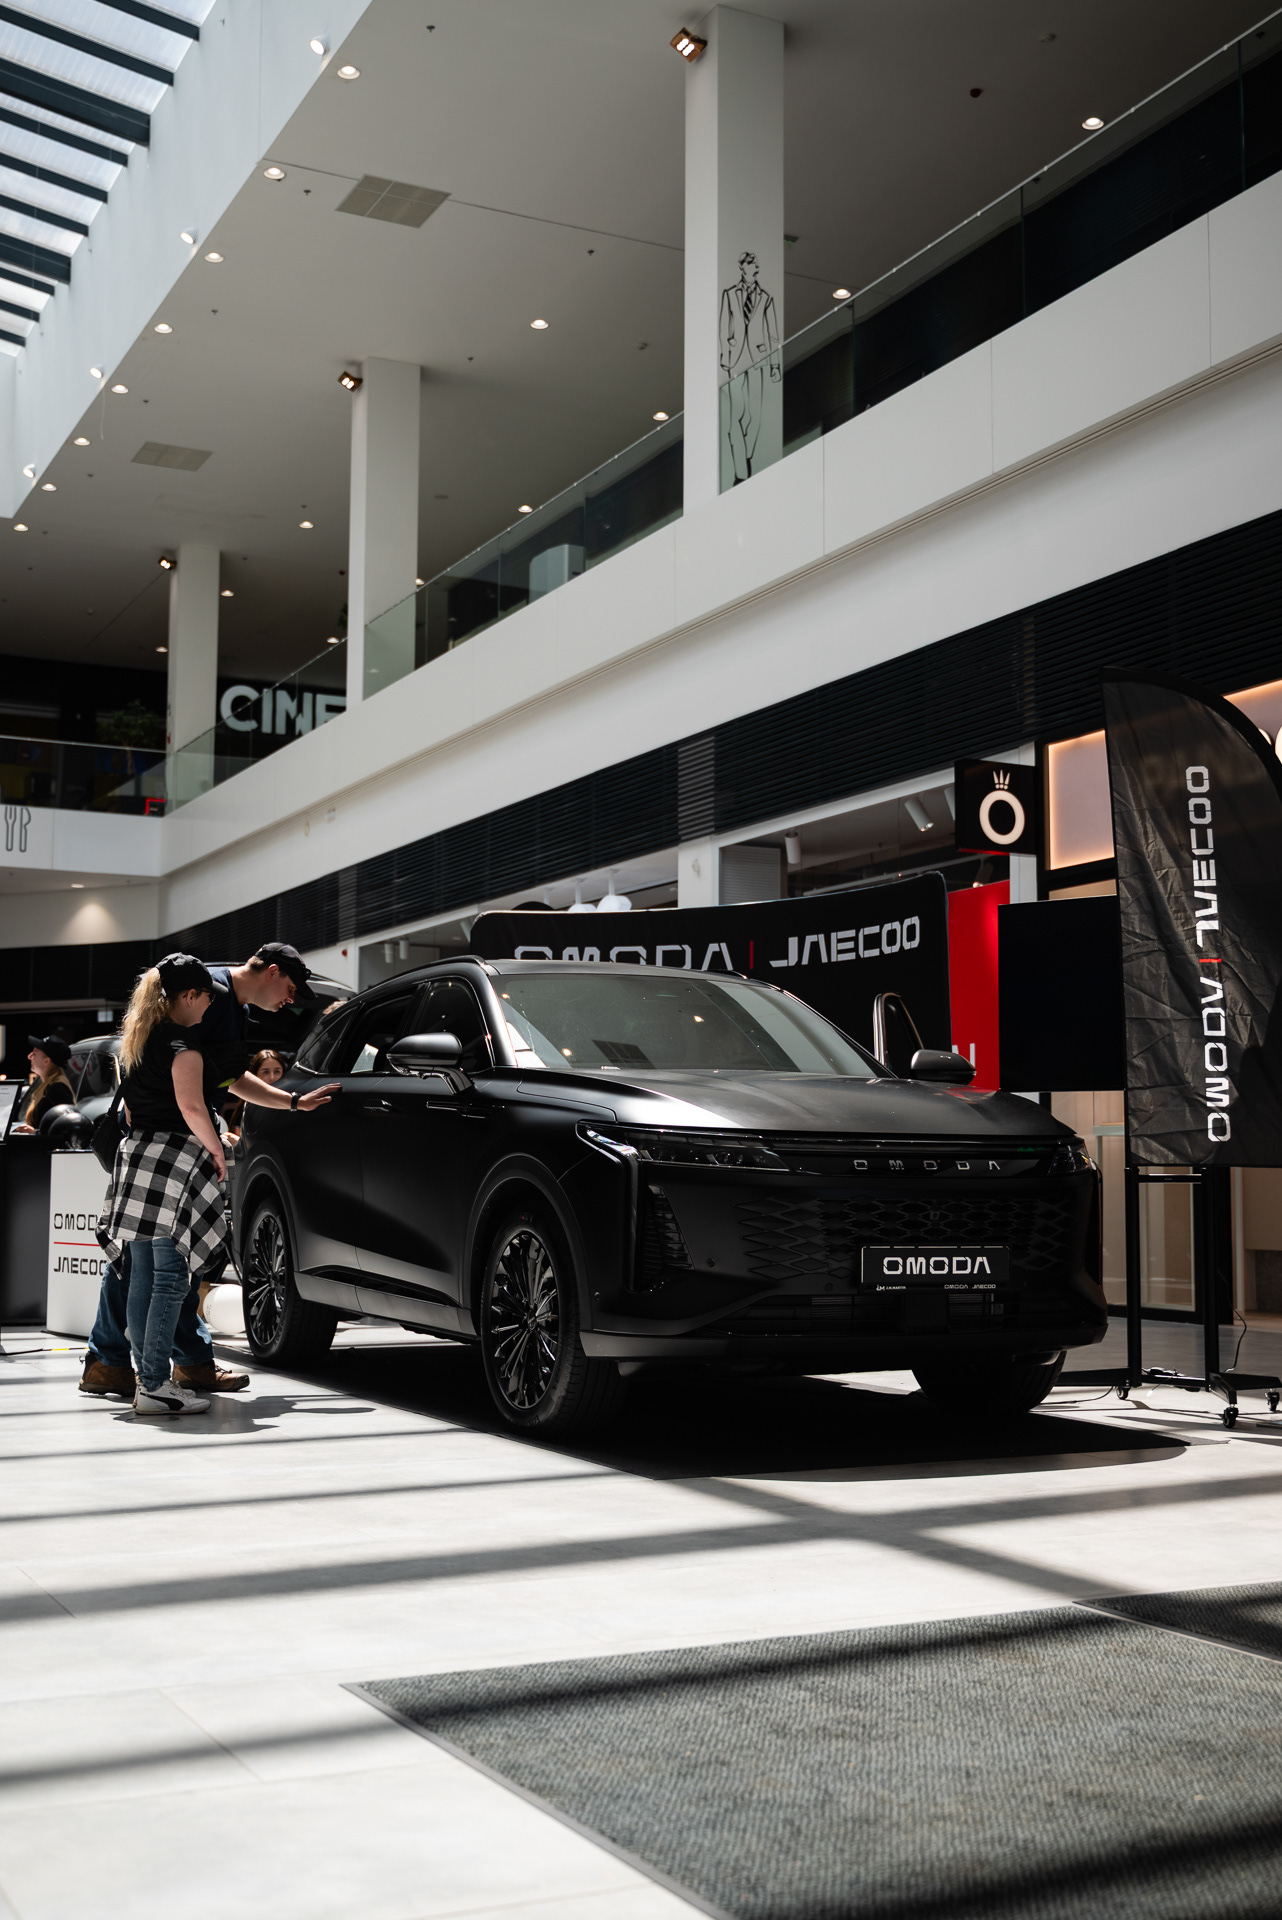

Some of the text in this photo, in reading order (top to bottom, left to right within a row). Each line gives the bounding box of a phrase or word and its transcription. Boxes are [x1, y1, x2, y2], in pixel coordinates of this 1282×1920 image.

[768, 915, 921, 968] JAECOO
[1185, 765, 1231, 1142] OMODA JAECOO
[853, 1160, 1000, 1170] OMODA
[53, 1213, 98, 1231] OMOD
[883, 1256, 992, 1275] OMODA
